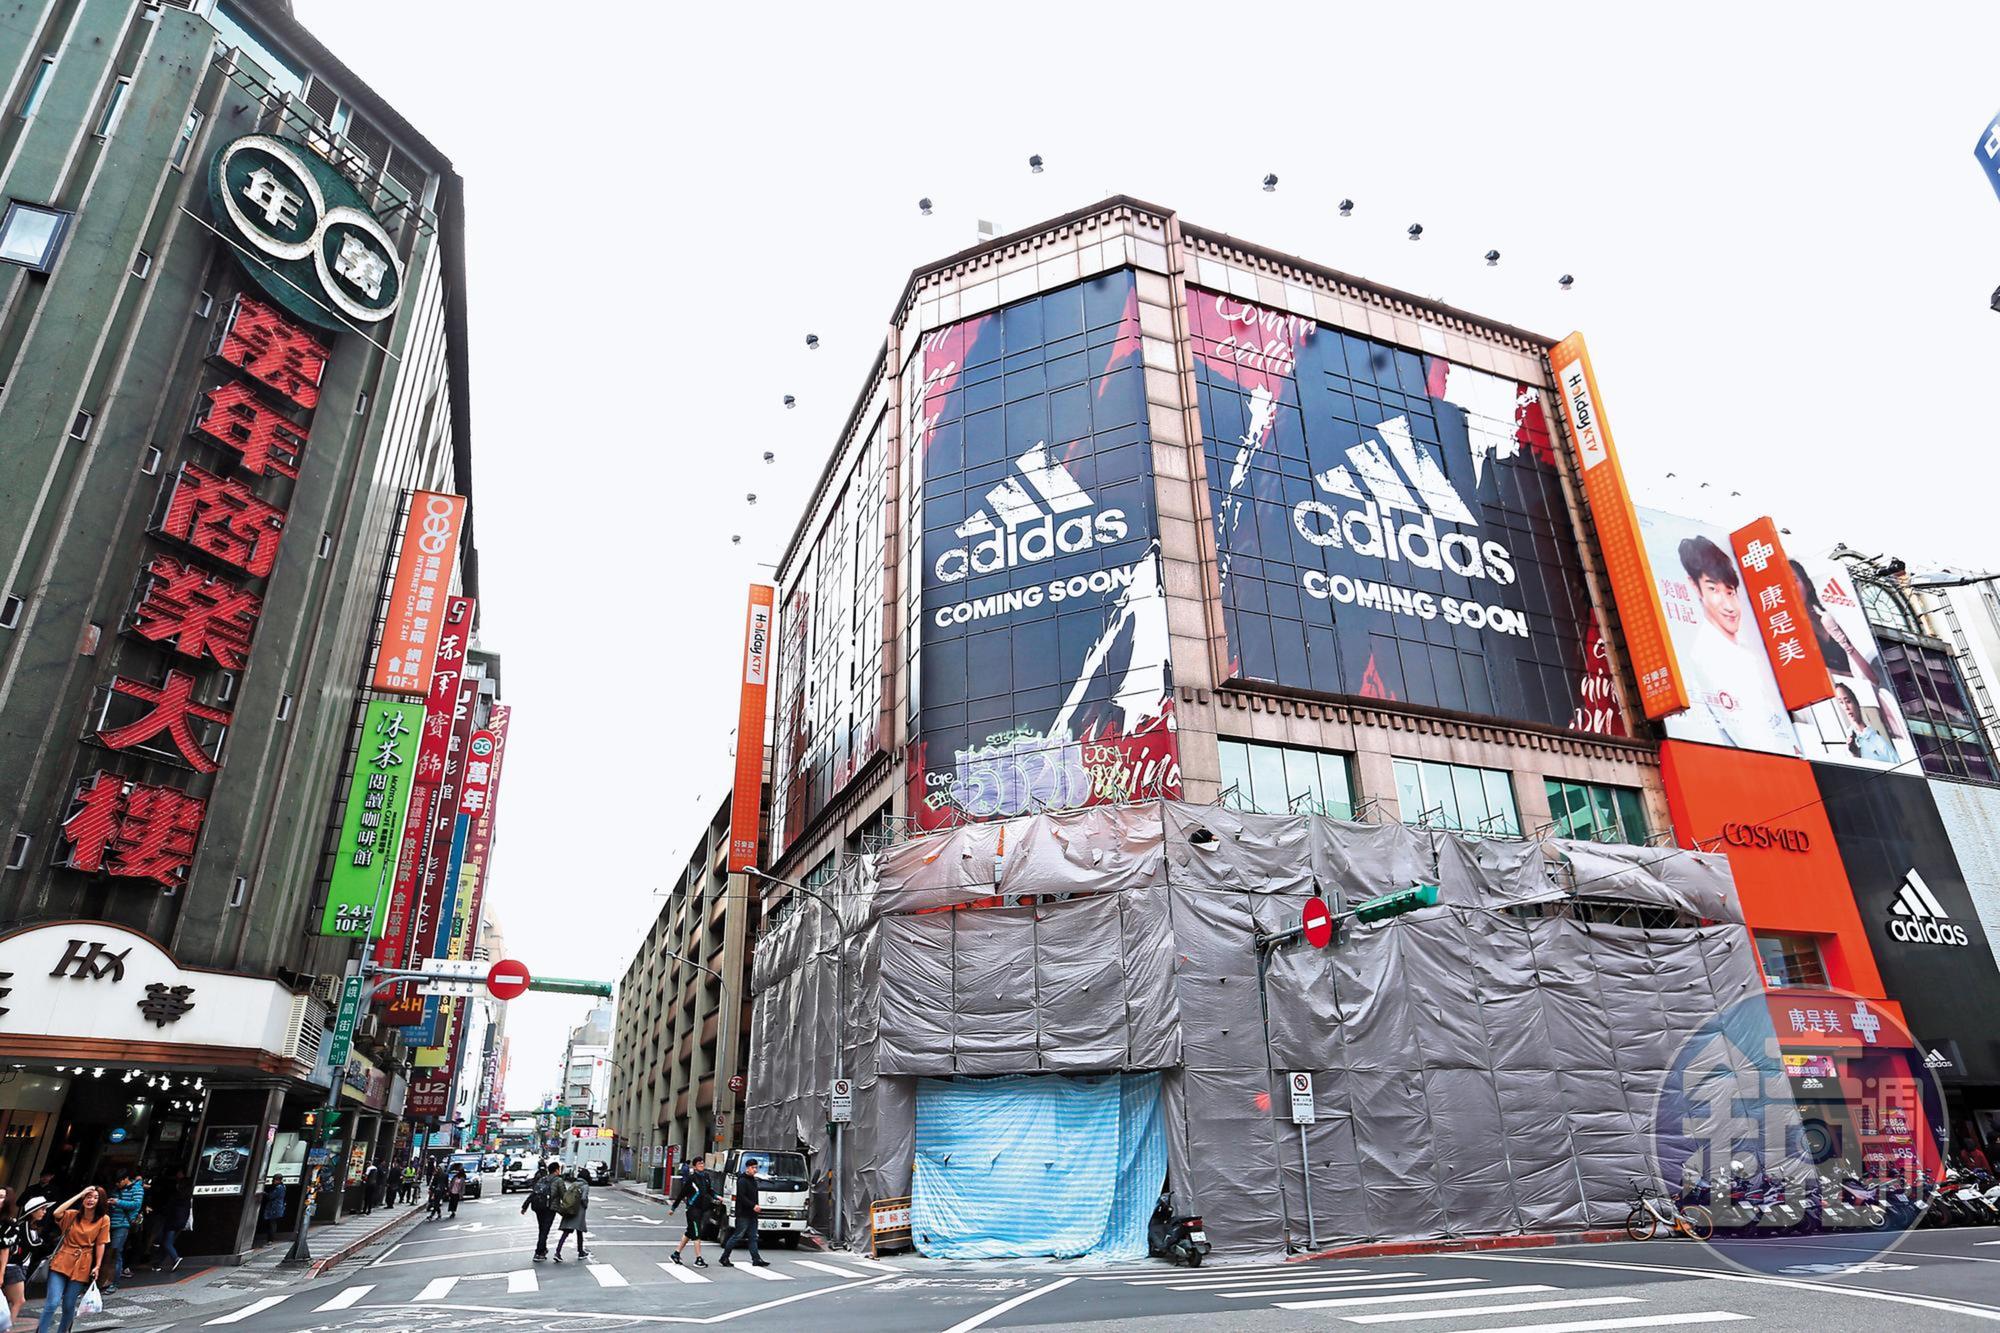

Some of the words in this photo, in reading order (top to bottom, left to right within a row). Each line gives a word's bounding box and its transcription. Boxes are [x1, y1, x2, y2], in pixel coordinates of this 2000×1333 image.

[1569, 374, 1591, 431] Holiday
[1583, 427, 1599, 452] KTV
[934, 508, 1130, 583] adidas
[1293, 498, 1515, 585] adidas
[935, 587, 1045, 628] COMING
[1048, 565, 1133, 601] SOON
[1303, 570, 1438, 621] COMING
[1442, 593, 1530, 638] SOON
[750, 613, 767, 655] Holiday
[1759, 584, 1806, 668] 康是美
[386, 675, 419, 689] 10F-1
[751, 655, 762, 676] KTV
[461, 761, 490, 812] 萬年
[1723, 822, 1811, 854] COSMED
[1891, 914, 1968, 946] adidas
[1788, 1008, 1844, 1033] 康是美
[1923, 1060, 1953, 1069] adidas
[414, 1082, 446, 1094] U2
